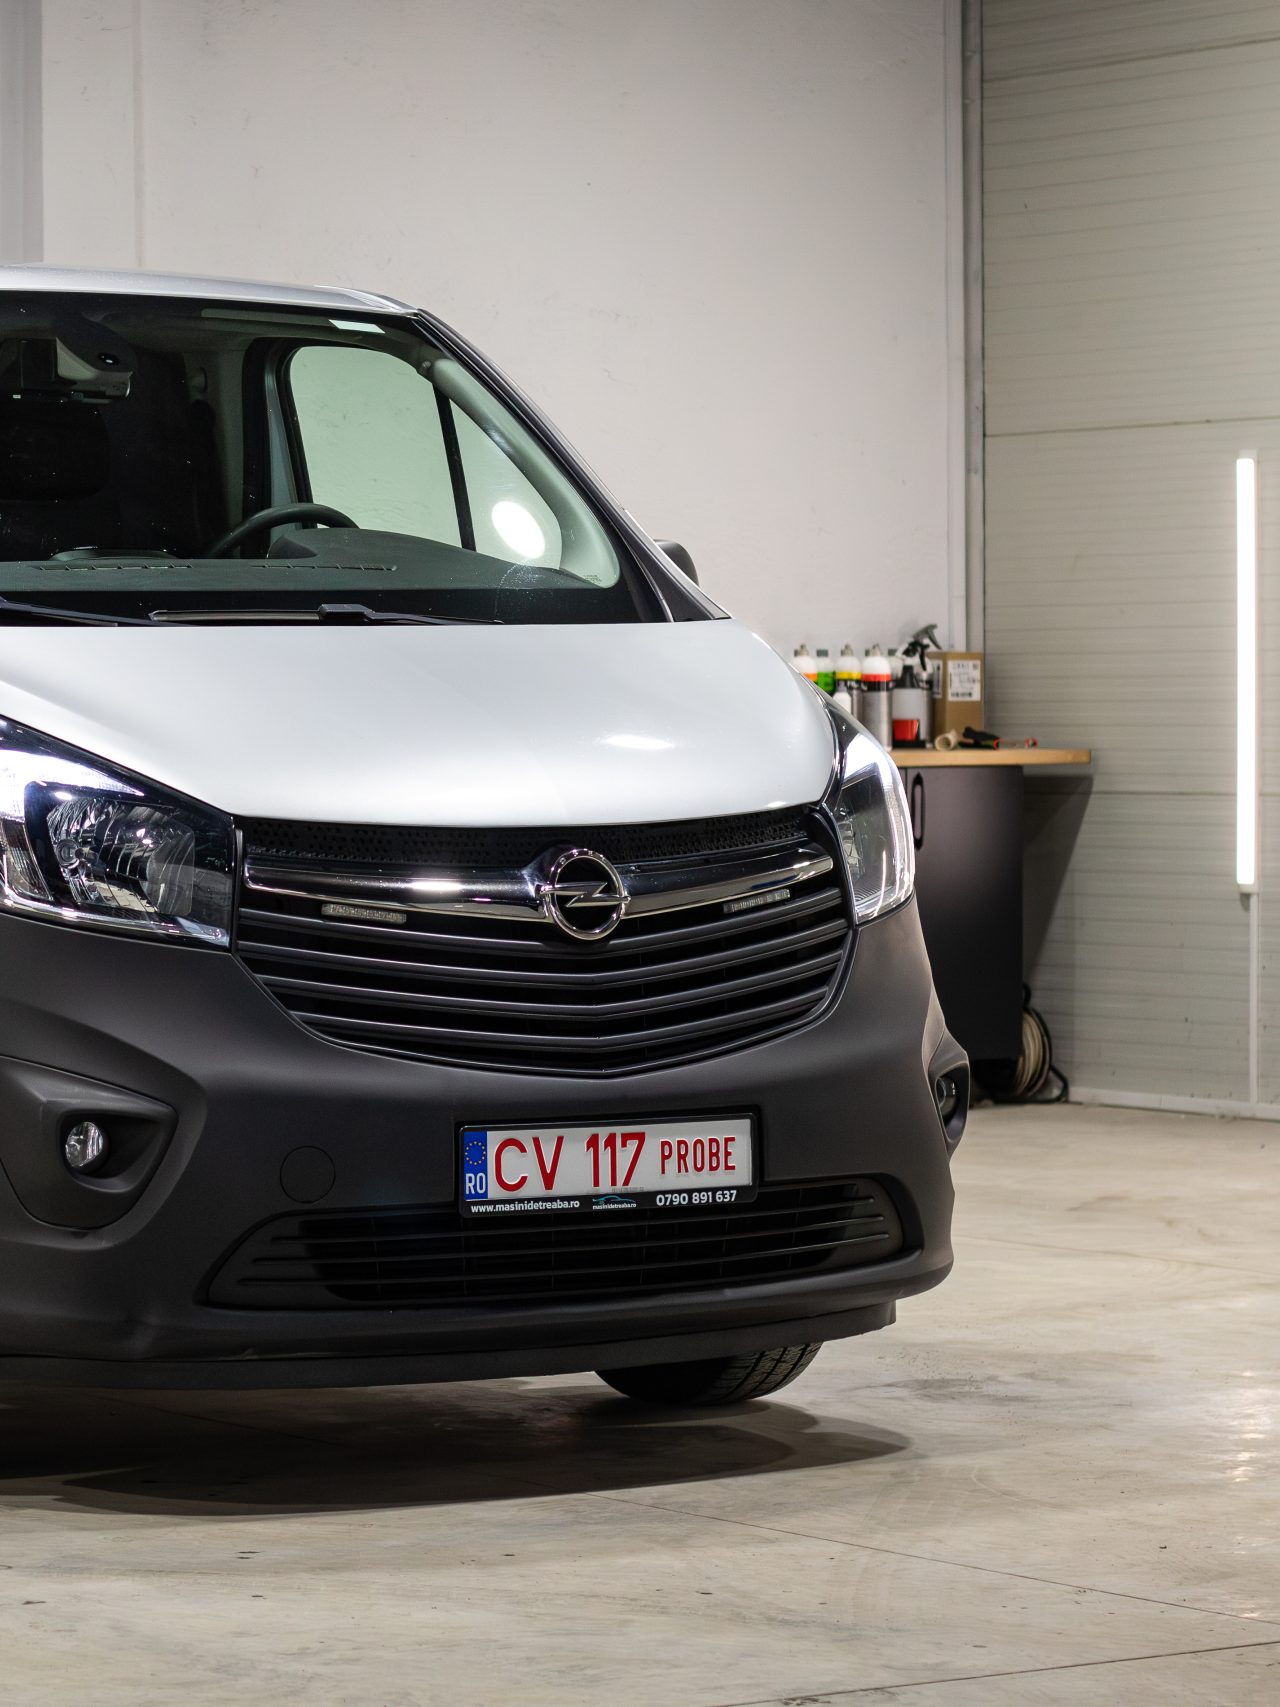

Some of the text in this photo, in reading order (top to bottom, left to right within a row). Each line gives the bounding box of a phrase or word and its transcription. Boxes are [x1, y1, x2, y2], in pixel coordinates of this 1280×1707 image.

[494, 1131, 736, 1192] CV 117 PROBE
[465, 1172, 487, 1195] RO
[471, 1200, 580, 1212] www.masinidetreaba.ro
[656, 1190, 737, 1206] 0790 891 637
